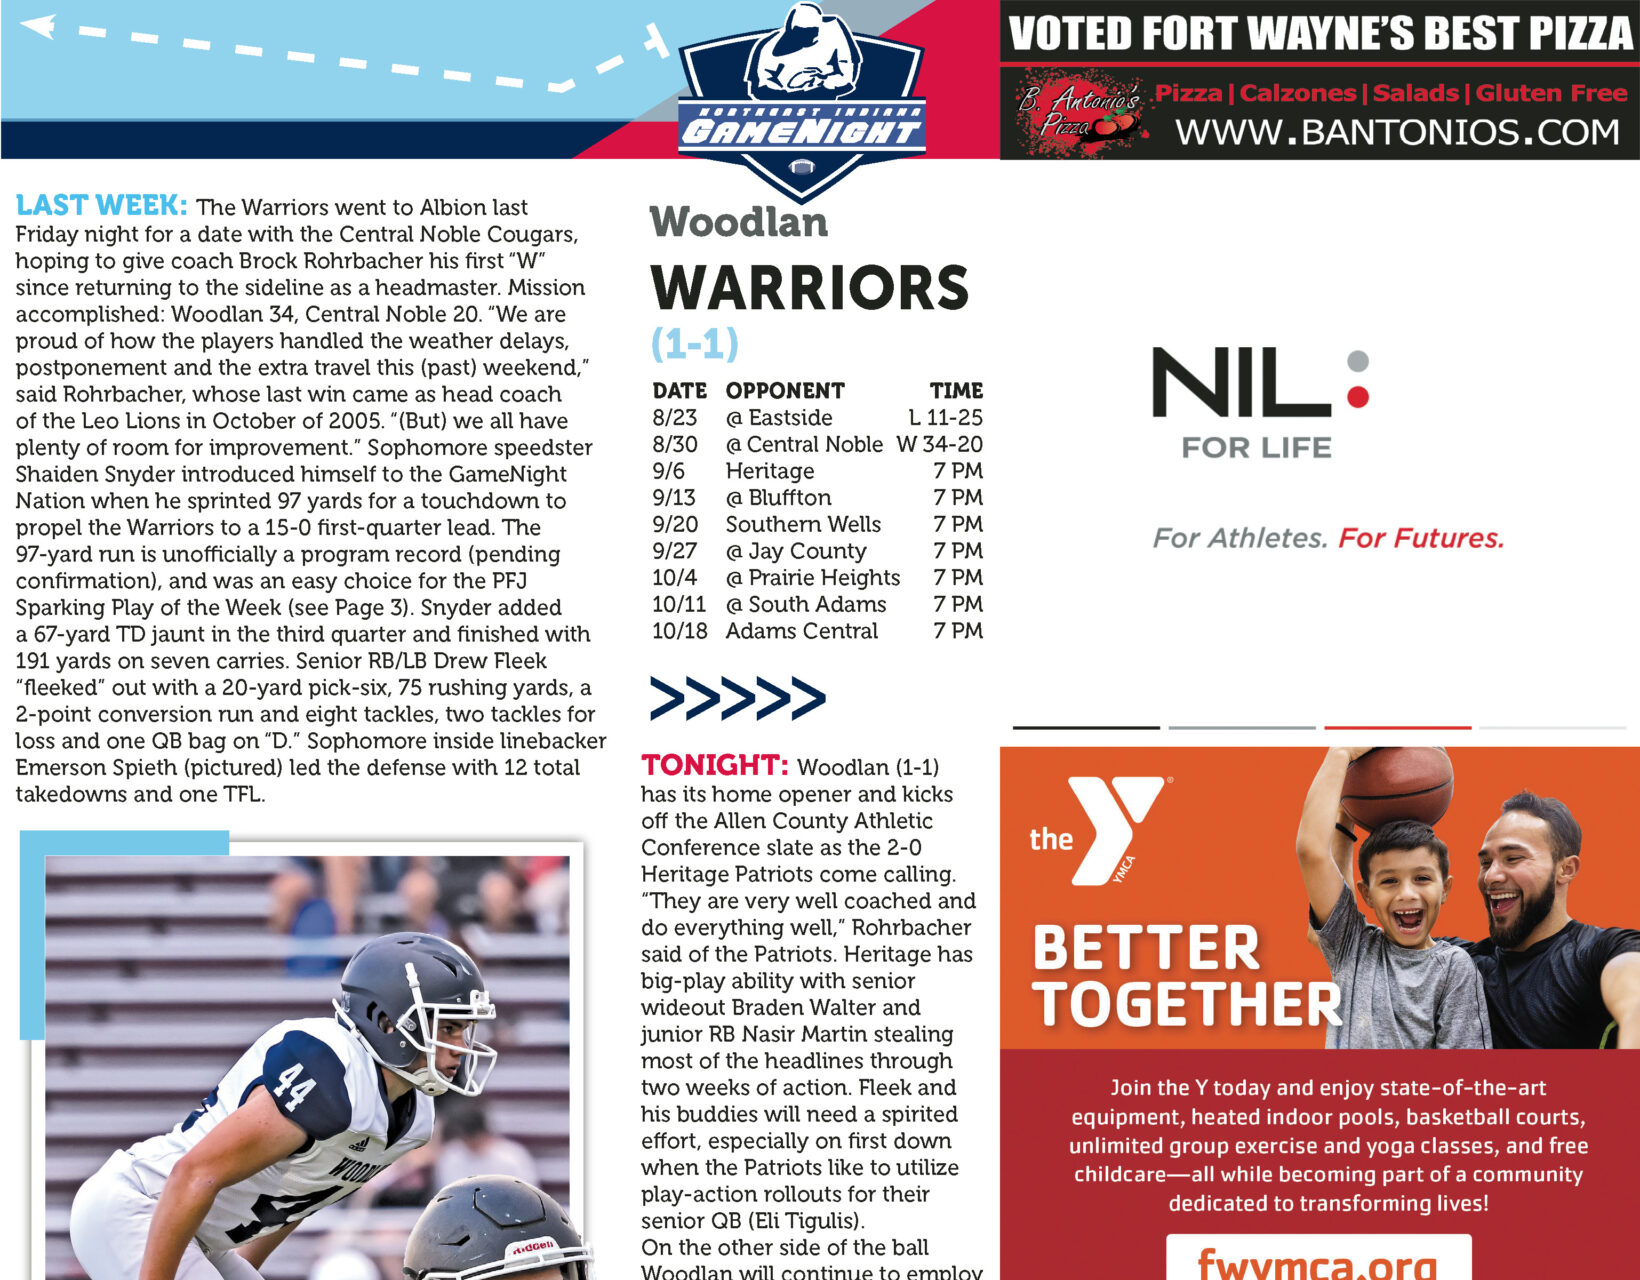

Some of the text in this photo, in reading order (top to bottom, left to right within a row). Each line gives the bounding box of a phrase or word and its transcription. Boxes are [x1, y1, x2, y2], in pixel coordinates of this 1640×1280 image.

[1009, 15, 1634, 50] VOTED FORT WAYNE'S BEST PIZZA
[1019, 86, 1041, 111] B.
[1156, 84, 1627, 101] Pizza Calzones Salads Gluten Free
[834, 107, 921, 117] INDIANA
[1040, 111, 1090, 136] Pizza
[1176, 119, 1618, 145] WWW.BANTONIOS.COM
[16, 194, 528, 216] LAST WEEK: The Warriors went to Albion last
[650, 207, 828, 237] Woodlan
[650, 264, 968, 310] WARRIORS
[652, 327, 738, 363] (1-1)
[653, 382, 983, 399] DATE OPPONENT TIME
[1153, 347, 1332, 417] NIL
[653, 408, 983, 428] 8/23 @ Eastside L 11-25
[1183, 437, 1331, 458] FOR LIFE
[1154, 527, 1503, 548] For Athletes. For Futures.
[654, 622, 983, 640] 10/18 Adams Central 7 PM
[17, 651, 547, 673] 191 yards on seven carries. Senior RB/LB Drew Fleek
[641, 753, 938, 777] TONIGHT: Woodlan (1-1)
[16, 785, 265, 802] takedowns and one TFL.
[1030, 826, 1073, 850] the
[641, 865, 955, 887] Heritage Patriots come calling.
[1112, 855, 1136, 884] YMCA
[1033, 924, 1260, 970] BETTER
[1033, 980, 1344, 1028] TOGETHER
[273, 1062, 317, 1113] 44
[1111, 1079, 1546, 1100] Join the Y today and enjoy state-of-the-art
